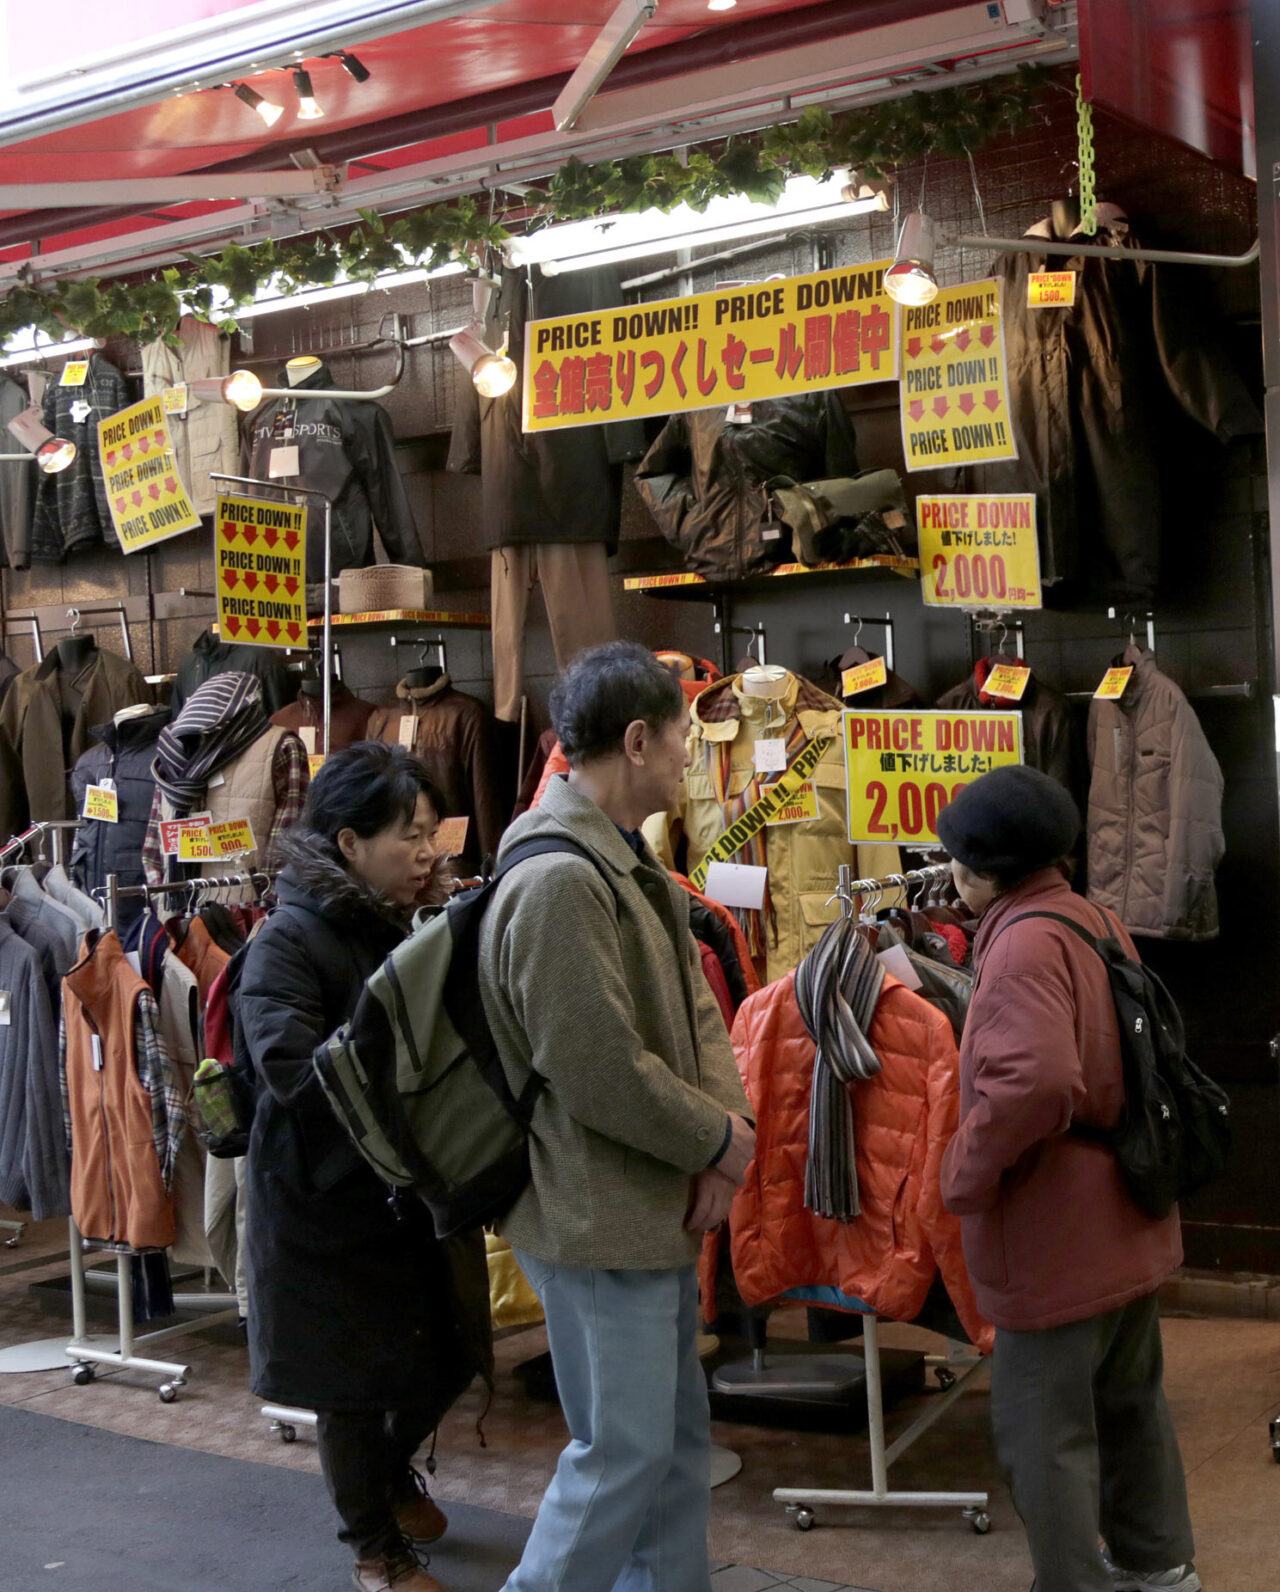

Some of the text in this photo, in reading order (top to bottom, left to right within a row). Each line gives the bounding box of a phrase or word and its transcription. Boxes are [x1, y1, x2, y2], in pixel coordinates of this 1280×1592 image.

[537, 320, 602, 353] PRICE
[613, 303, 699, 343] DOWN!!
[715, 288, 785, 325] PRICE
[907, 304, 940, 331] PRICE
[533, 304, 890, 418] 全館売りつくしセール開催中
[907, 366, 942, 393] PRICE
[103, 425, 126, 447] PRICE
[910, 429, 949, 456] PRICE
[109, 470, 135, 494] PRICE
[221, 502, 255, 523] PRICE
[922, 502, 1031, 529] PRICE DOWN
[121, 516, 148, 541] PRICE
[941, 530, 1017, 546] 値下げしました!
[220, 550, 254, 570] PRICE
[222, 596, 256, 616] PRICE
[850, 718, 1014, 752] PRICE DOWN
[879, 752, 992, 773] 値下げしました!
[865, 780, 969, 840] 2,00
[181, 829, 202, 838] PRICE
[209, 819, 248, 835] PRICE DOWN
[719, 796, 777, 855] DOWN
